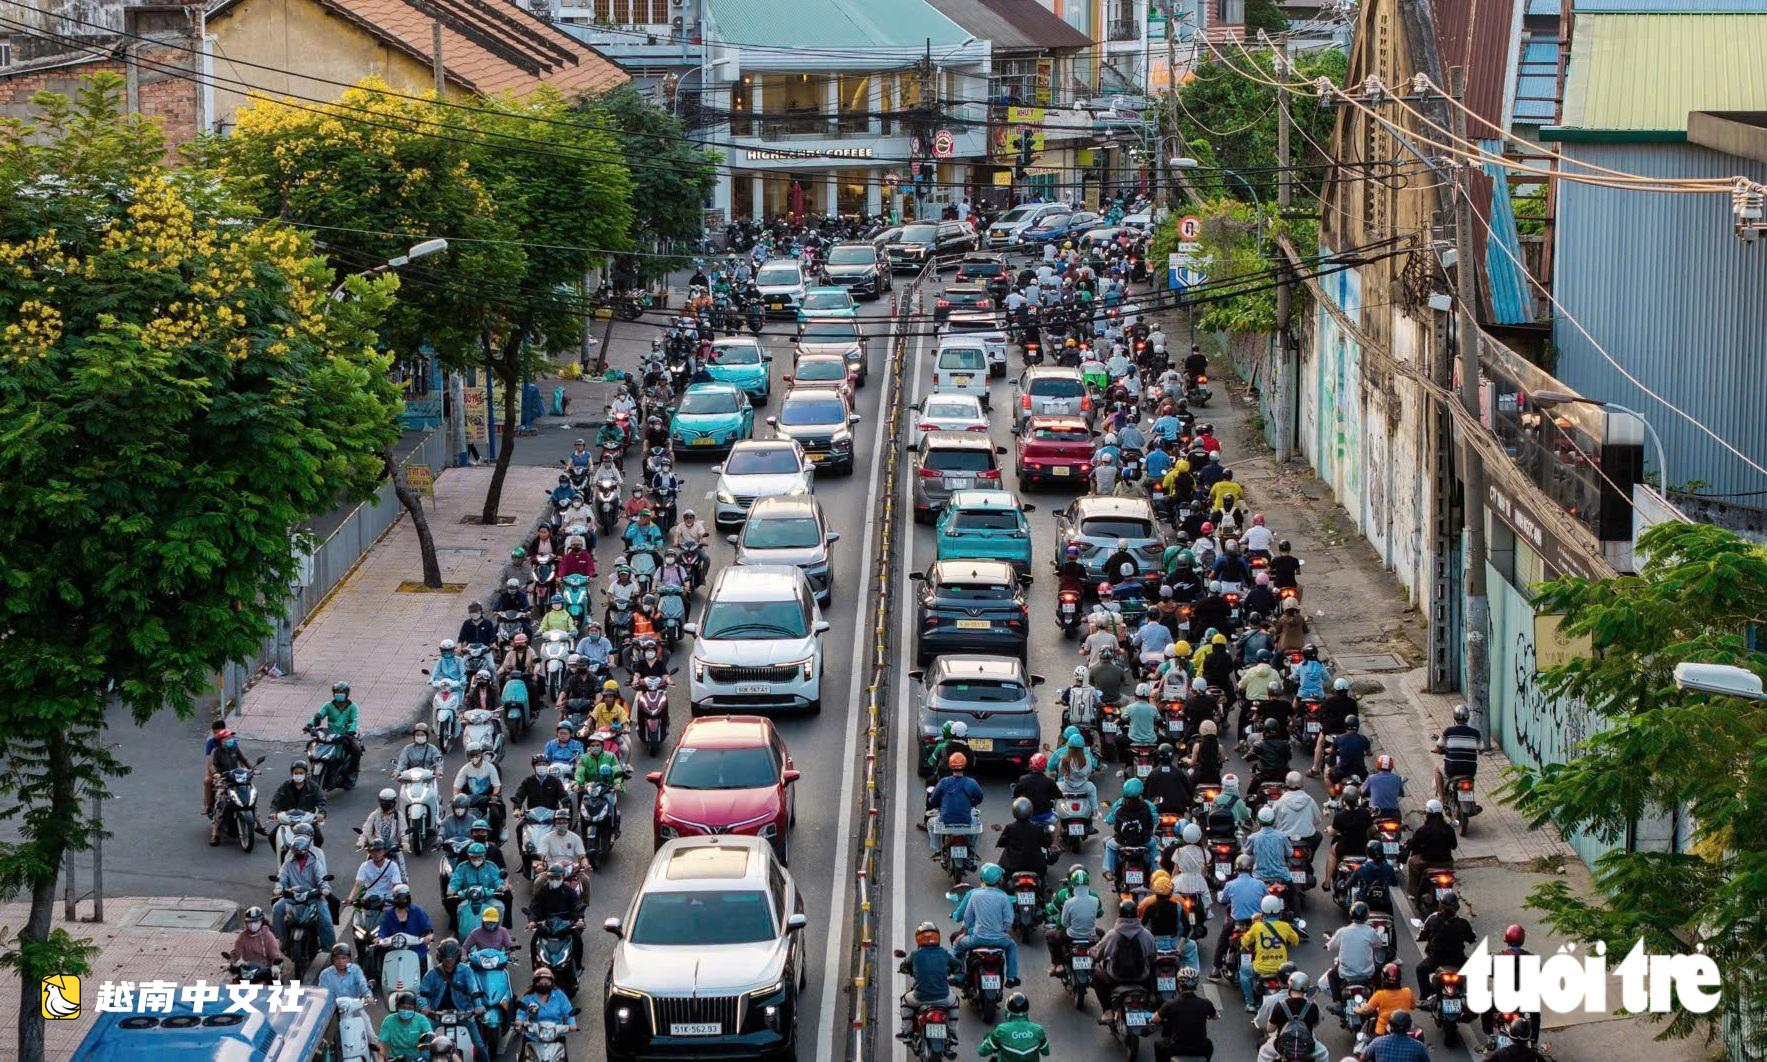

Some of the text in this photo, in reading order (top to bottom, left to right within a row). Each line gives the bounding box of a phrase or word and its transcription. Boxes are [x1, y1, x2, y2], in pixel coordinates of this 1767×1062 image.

[826, 148, 873, 159] COFFEE
[1260, 931, 1281, 950] be
[1011, 1030, 1034, 1040] Grab
